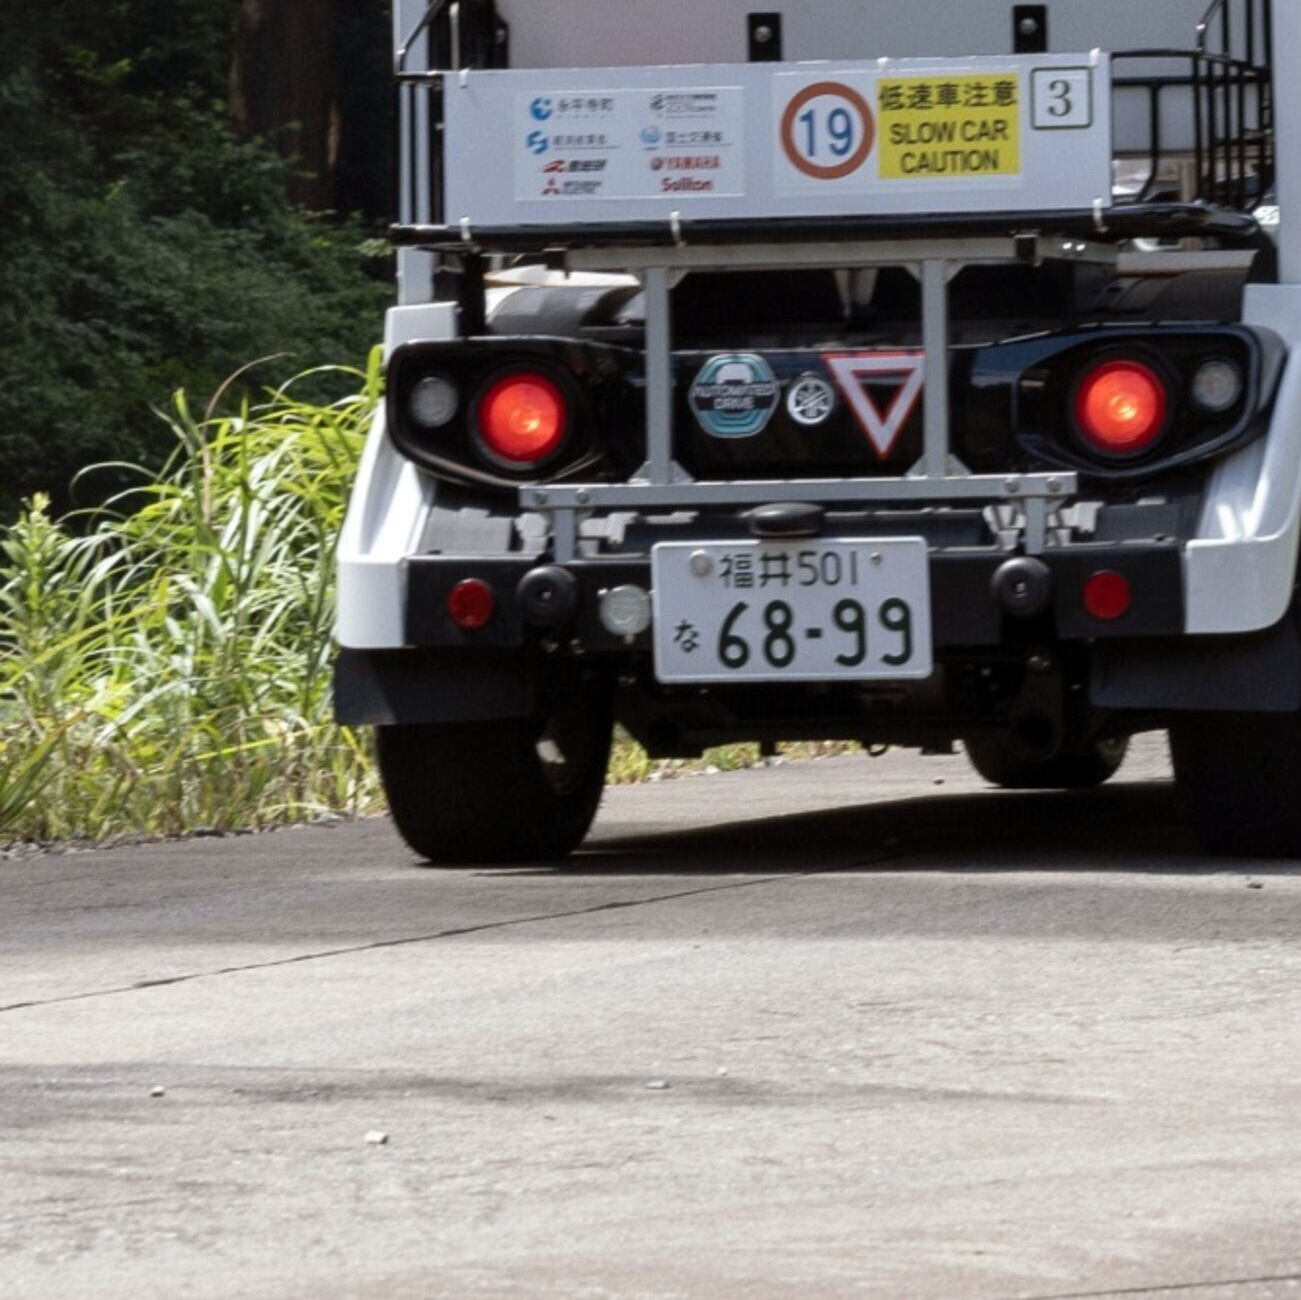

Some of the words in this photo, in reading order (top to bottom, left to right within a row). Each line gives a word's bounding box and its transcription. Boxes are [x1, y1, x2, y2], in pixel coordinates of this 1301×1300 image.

[879, 80, 1018, 111] 低速車注意
[1047, 79, 1072, 117] 3
[799, 107, 853, 157] 19
[889, 121, 957, 145] SLOW
[960, 119, 1010, 142] CAR
[900, 149, 1000, 174] CAUTION
[713, 396, 755, 410] DRIVE
[673, 619, 700, 653] な
[717, 597, 913, 668] 68-99
